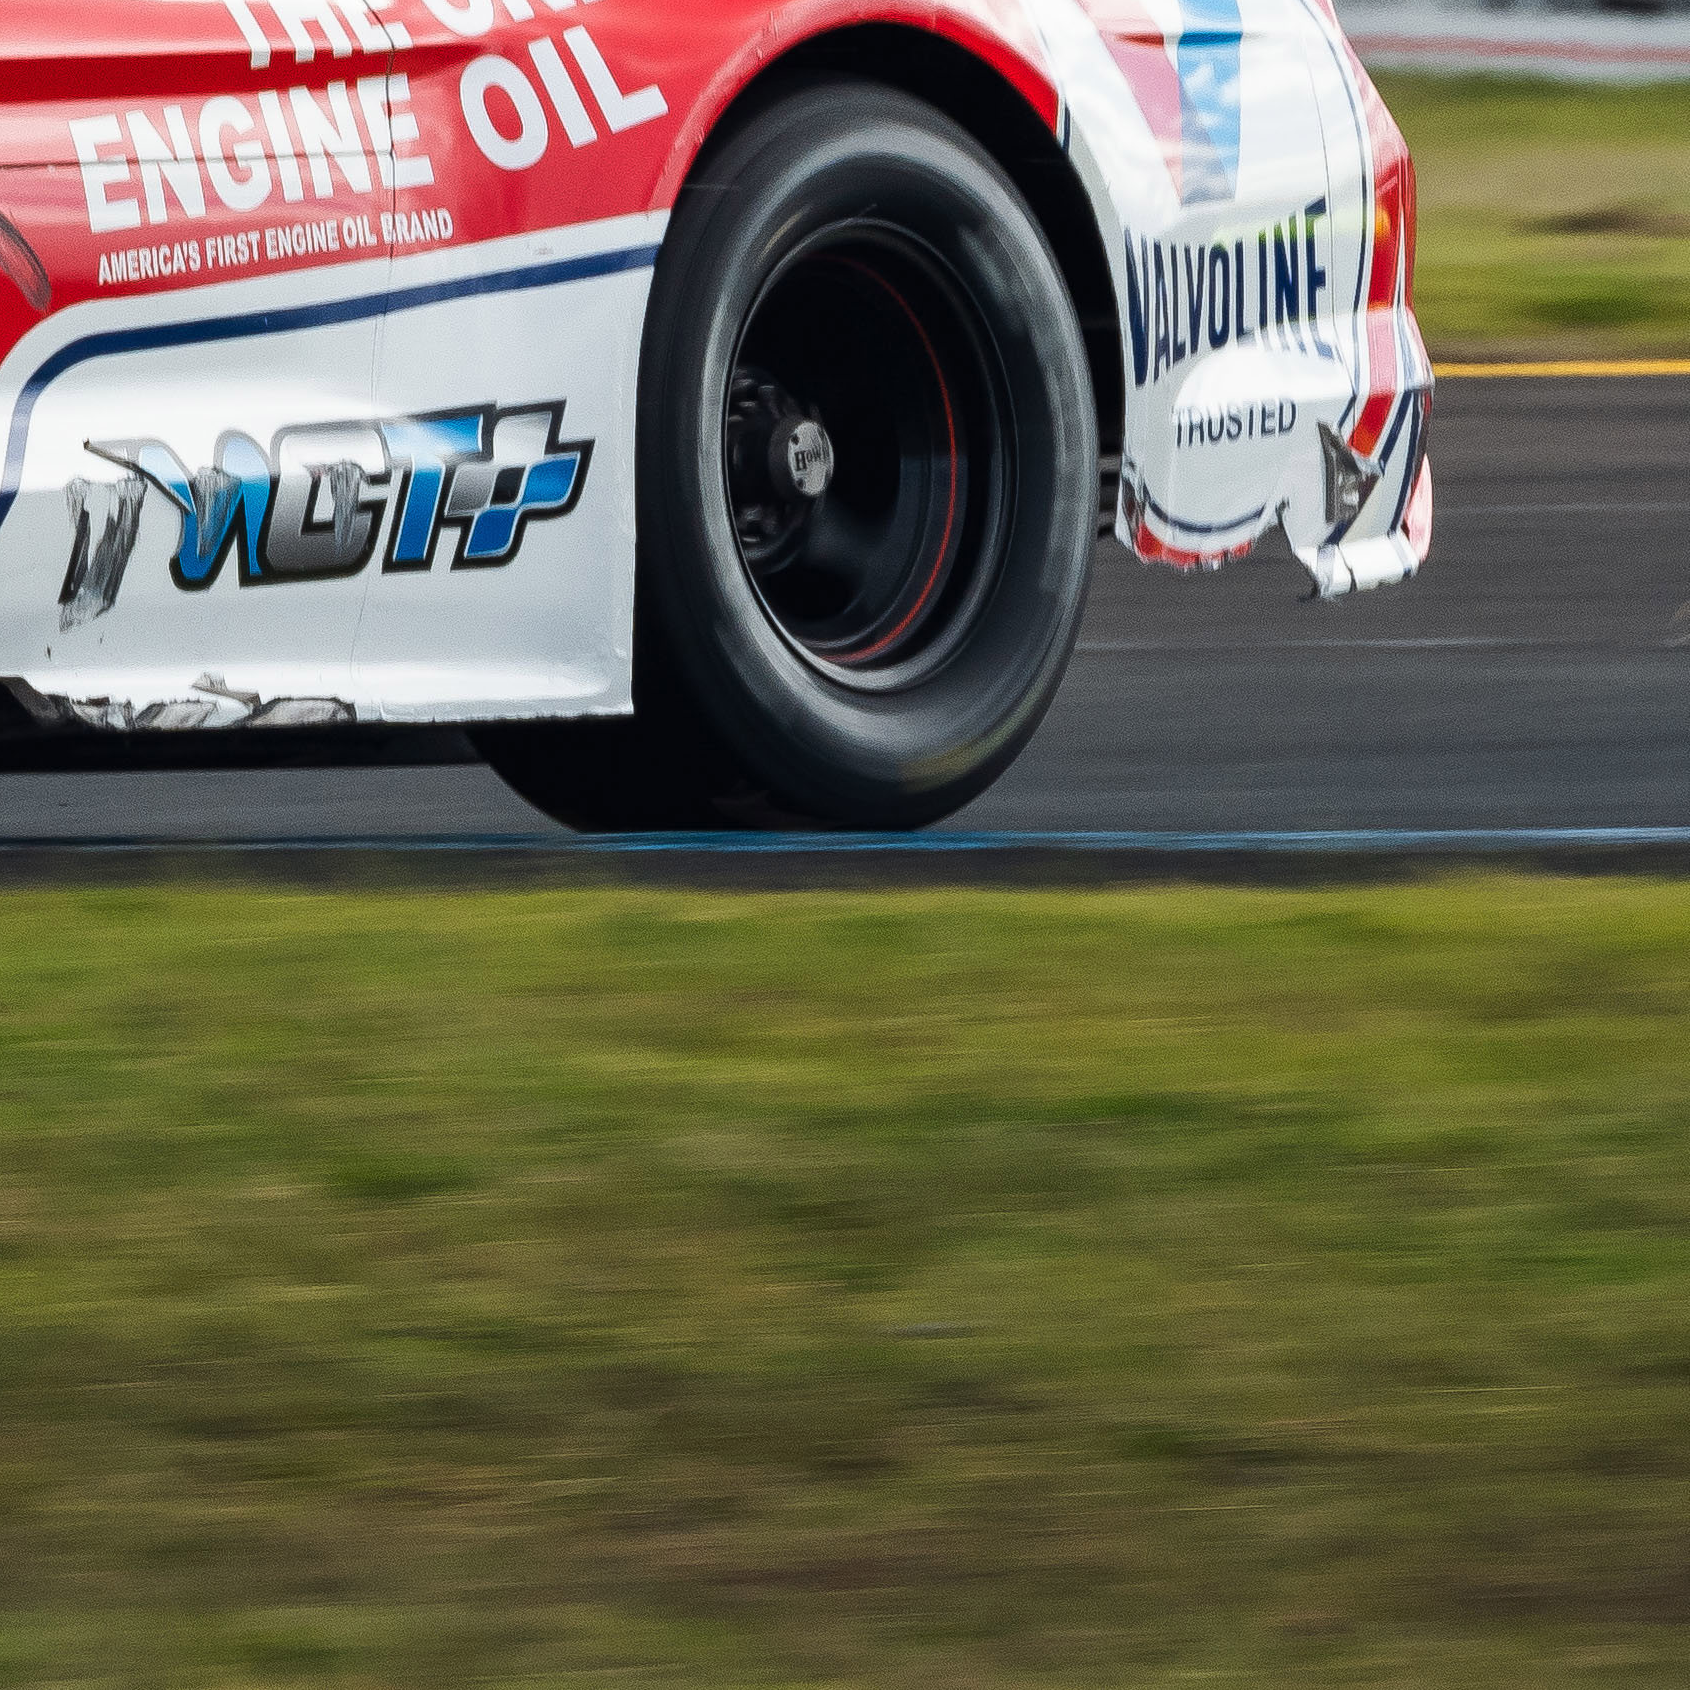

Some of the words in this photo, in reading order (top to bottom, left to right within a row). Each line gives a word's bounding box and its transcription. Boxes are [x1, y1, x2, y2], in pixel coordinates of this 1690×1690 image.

[67, 73, 434, 234] ENGINE
[459, 24, 669, 172] OIL
[97, 238, 201, 286] AMERICA'S
[205, 230, 262, 268] FIRST
[264, 218, 341, 260] ENGINE
[341, 213, 377, 248] OIL
[379, 207, 454, 244] BRAND
